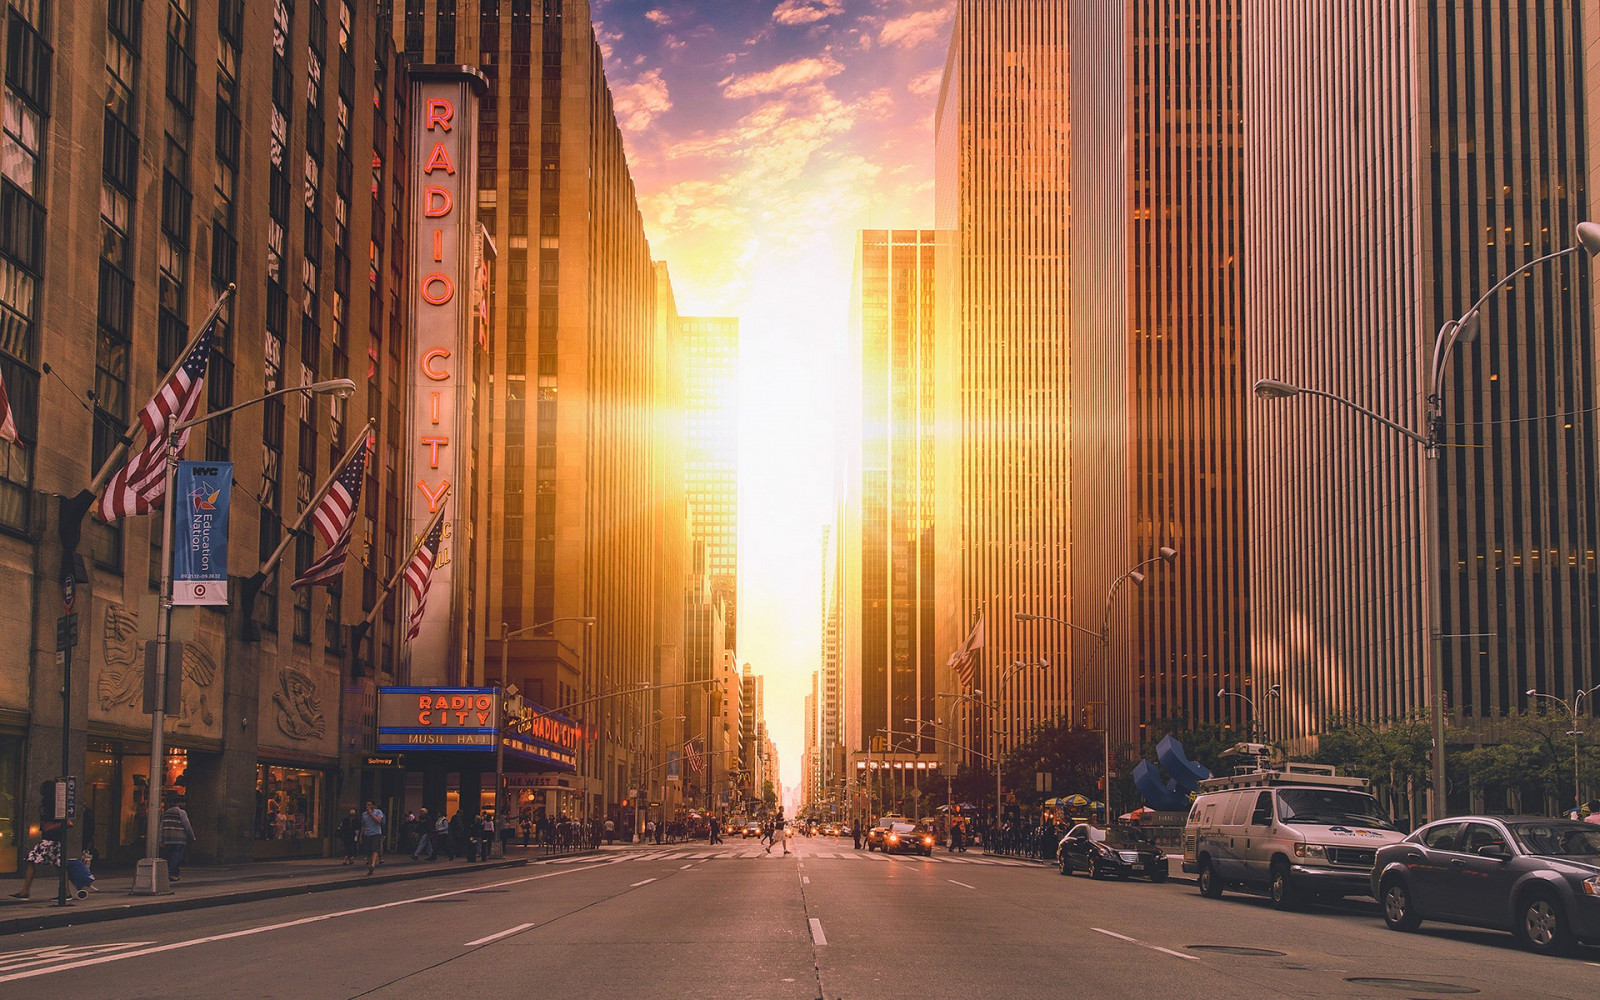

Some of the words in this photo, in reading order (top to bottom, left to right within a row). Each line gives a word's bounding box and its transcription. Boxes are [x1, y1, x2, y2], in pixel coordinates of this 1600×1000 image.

[421, 98, 456, 306] RADIO
[417, 347, 451, 514] CITY
[192, 466, 218, 477] NYC
[192, 514, 202, 552] Nation
[201, 514, 213, 571] Education
[419, 695, 492, 711] RADIO
[418, 711, 491, 726] CITY
[532, 711, 560, 743] RADIO
[408, 734, 444, 745] MUSIC
[367, 757, 393, 765] Subway
[525, 778, 551, 786] WEST
